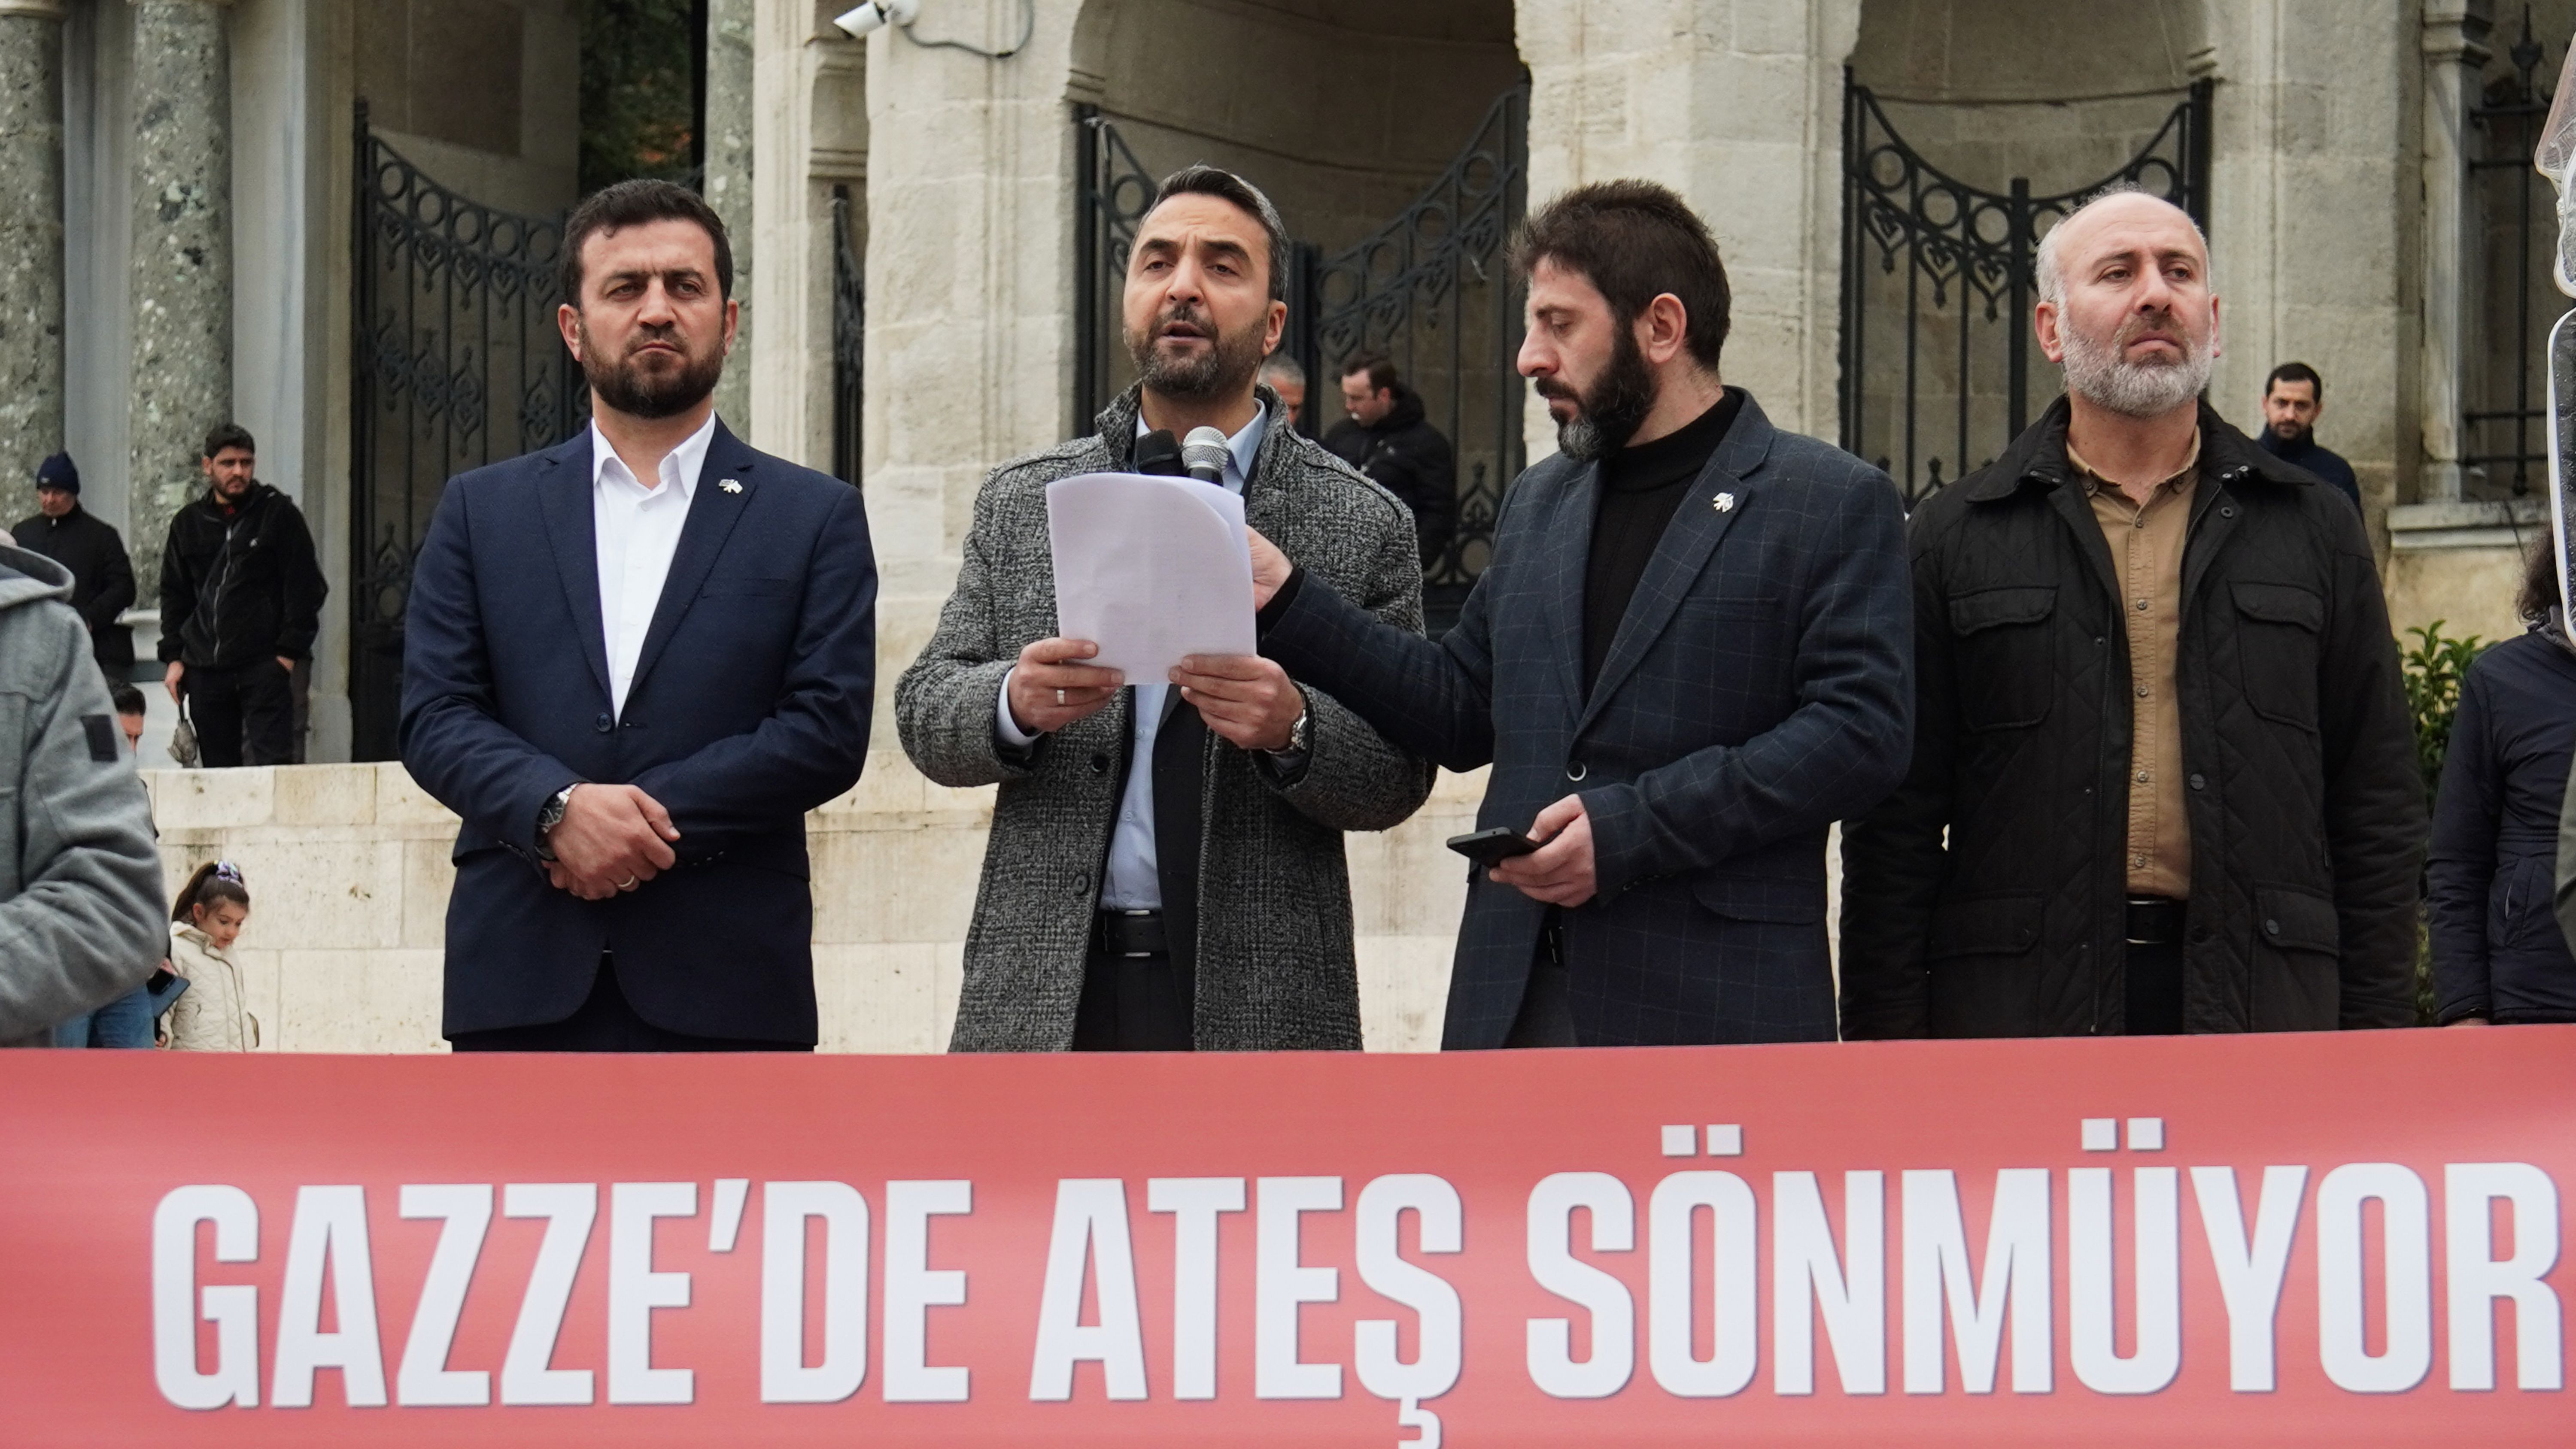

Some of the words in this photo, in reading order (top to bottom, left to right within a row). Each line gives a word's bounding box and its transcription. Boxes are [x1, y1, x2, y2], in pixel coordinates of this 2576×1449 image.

[152, 1178, 973, 1412] GAZZE'DE
[1028, 1173, 1465, 1449] ATEŞ
[1525, 1117, 2565, 1400] SÖNMÜYOR
